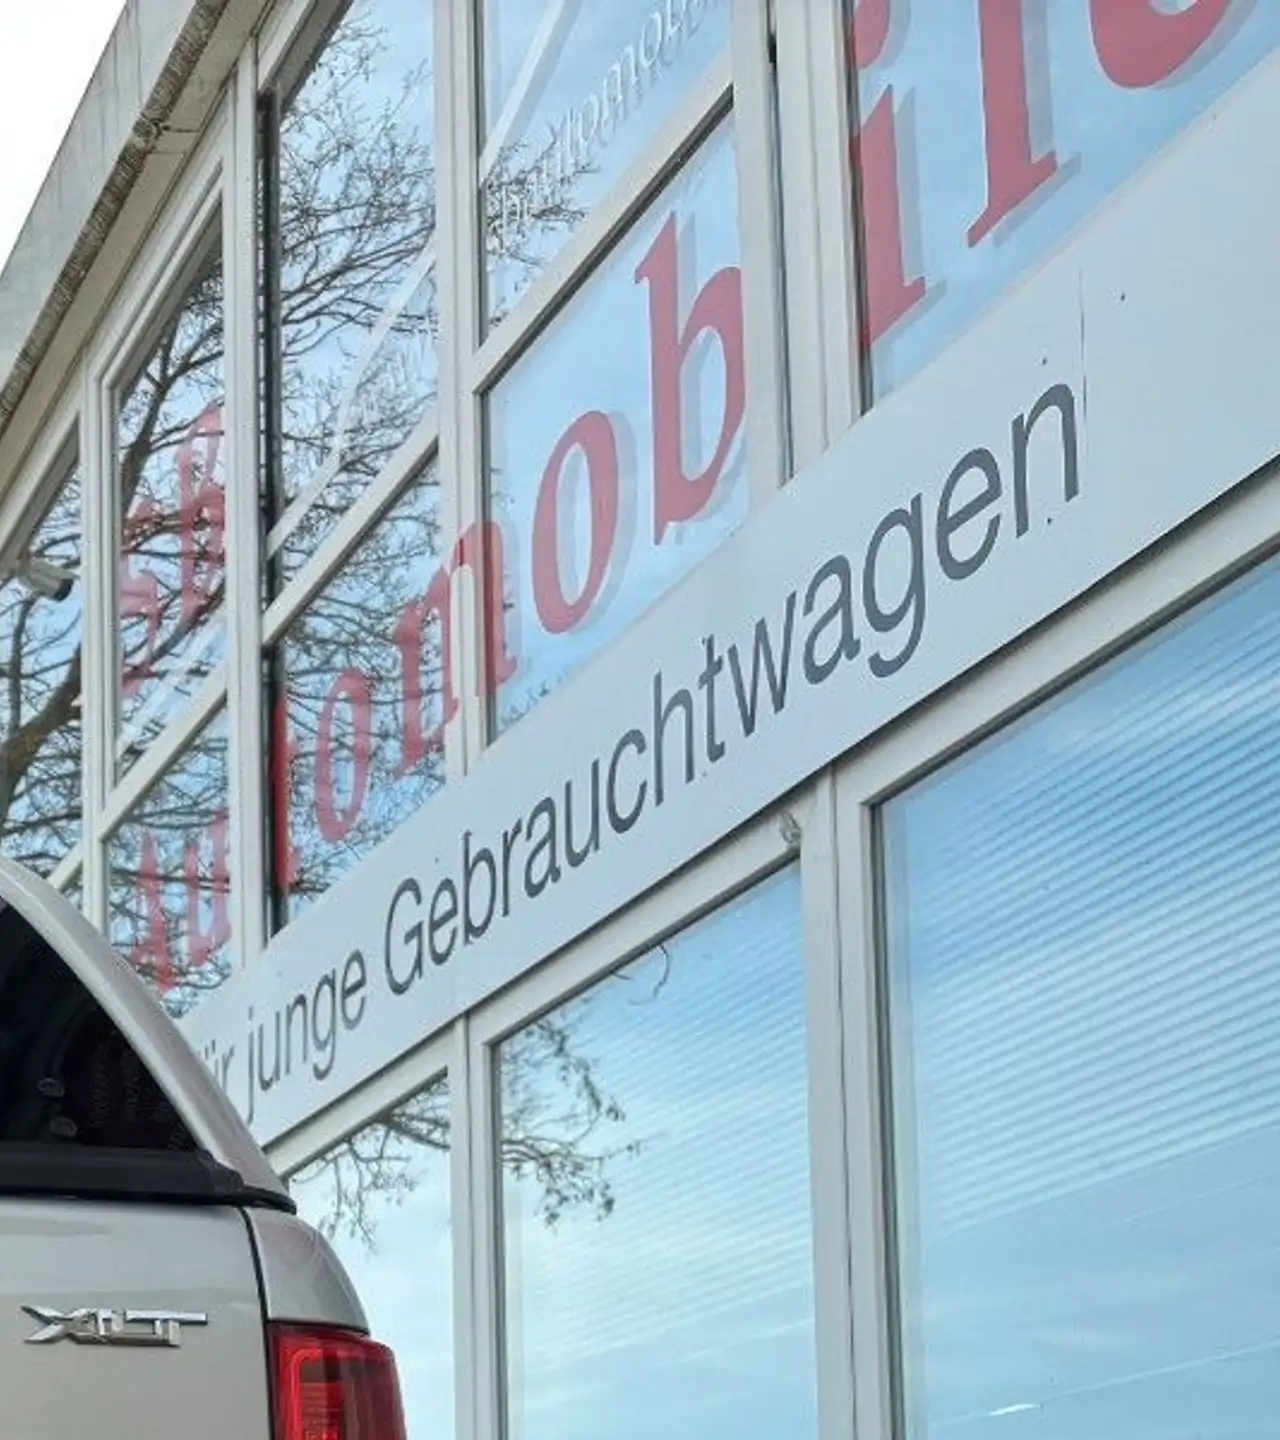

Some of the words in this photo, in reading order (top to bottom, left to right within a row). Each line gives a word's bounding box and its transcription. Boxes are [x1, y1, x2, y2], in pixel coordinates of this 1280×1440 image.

[130, 0, 1238, 992] Automobil
[246, 1005, 367, 1127] junge
[384, 383, 1080, 996] Gebrauchtwagen
[20, 1305, 209, 1348] XLT
